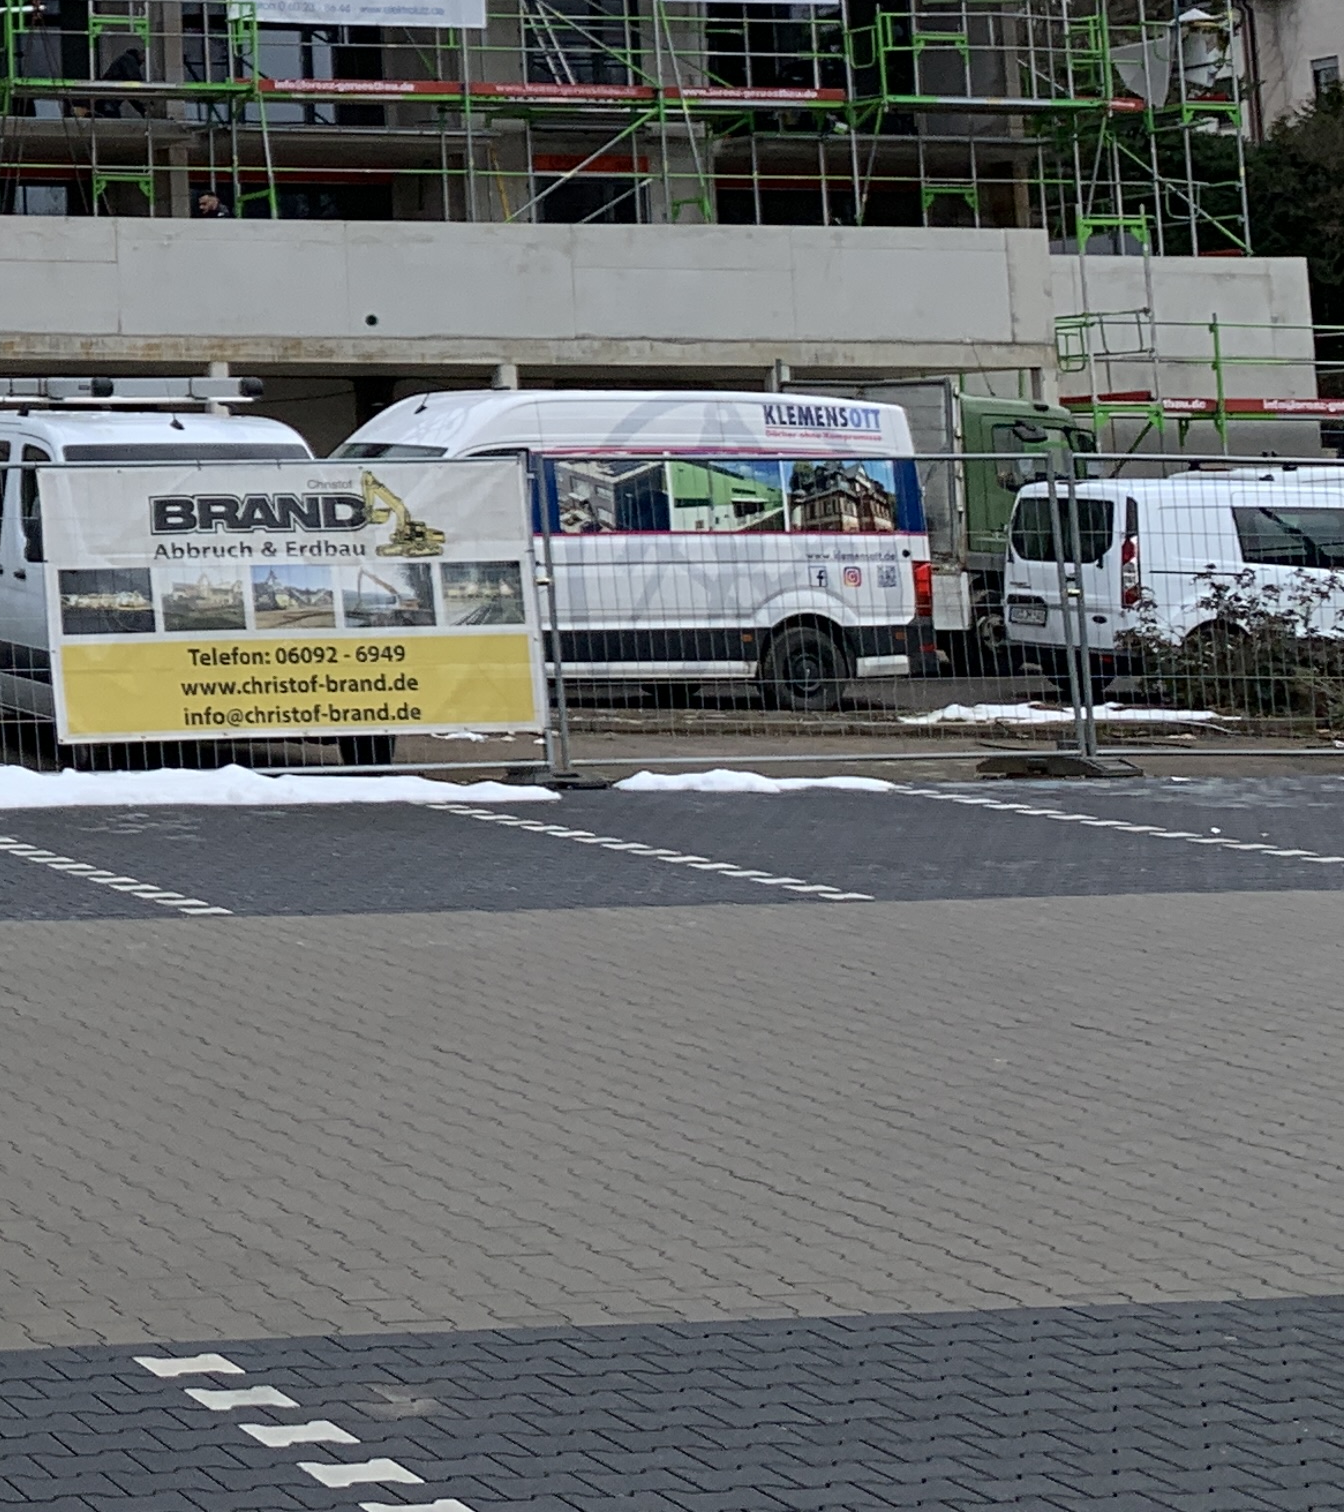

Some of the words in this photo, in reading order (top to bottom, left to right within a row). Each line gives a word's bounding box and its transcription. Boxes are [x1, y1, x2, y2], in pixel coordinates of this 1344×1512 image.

[763, 404, 880, 429] KLEMENSOTT
[306, 478, 354, 491] Christof
[149, 491, 368, 536] BRAND
[153, 541, 253, 560] Abbruch
[259, 541, 278, 558] &
[285, 538, 366, 559] Erdbau
[188, 647, 271, 667] Telefon:
[274, 646, 339, 665] 06092
[355, 644, 406, 664] 6949
[181, 672, 419, 697] www.christof-brand.de
[183, 702, 422, 728] info@christof-brand.de
